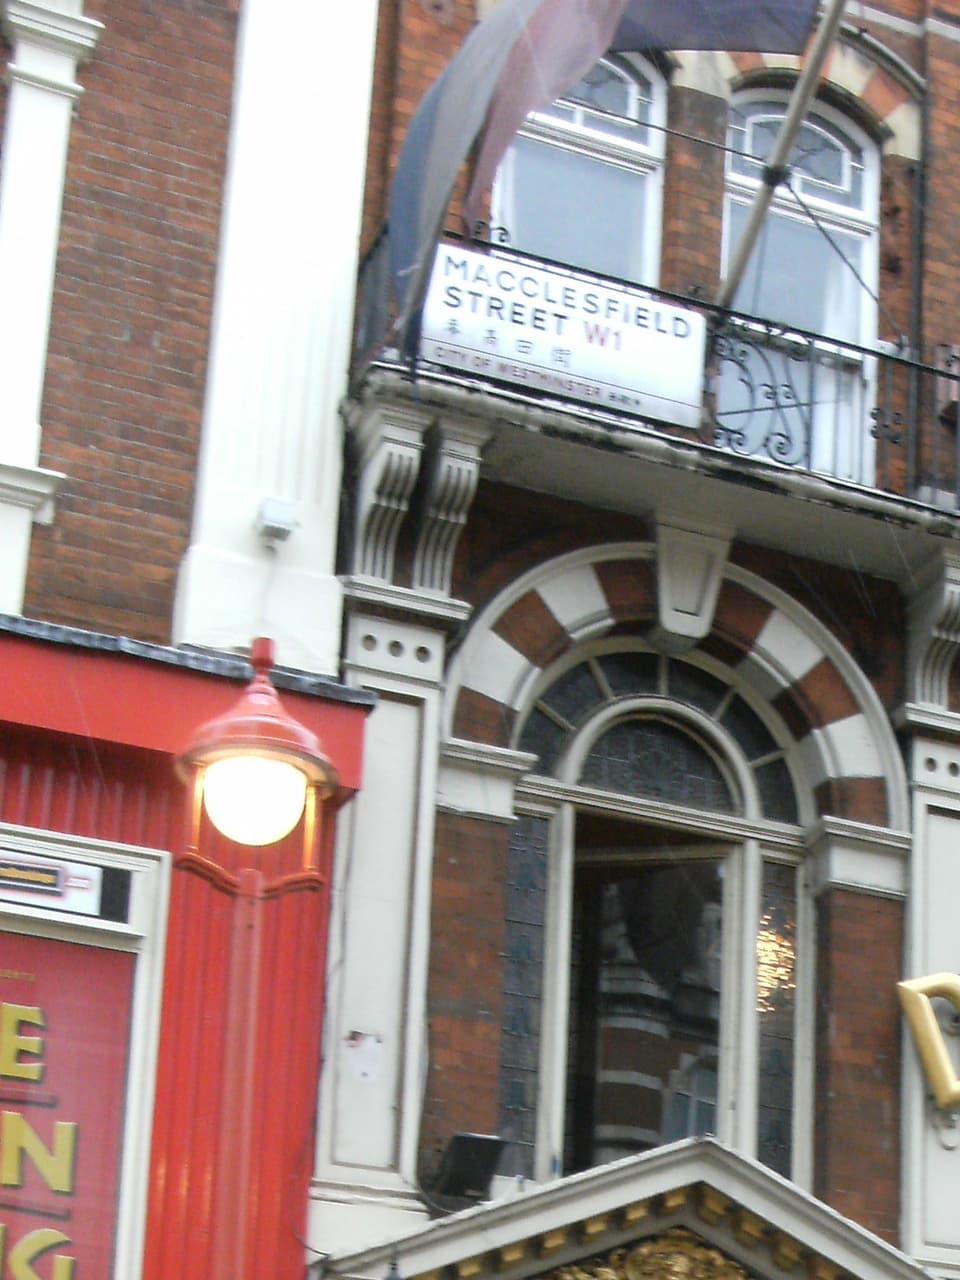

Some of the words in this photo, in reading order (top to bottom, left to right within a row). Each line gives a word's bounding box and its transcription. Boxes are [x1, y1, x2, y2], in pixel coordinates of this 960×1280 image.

[442, 286, 570, 331] STREET
[583, 320, 622, 351] W1
[443, 255, 692, 339] MACCLESFIELD
